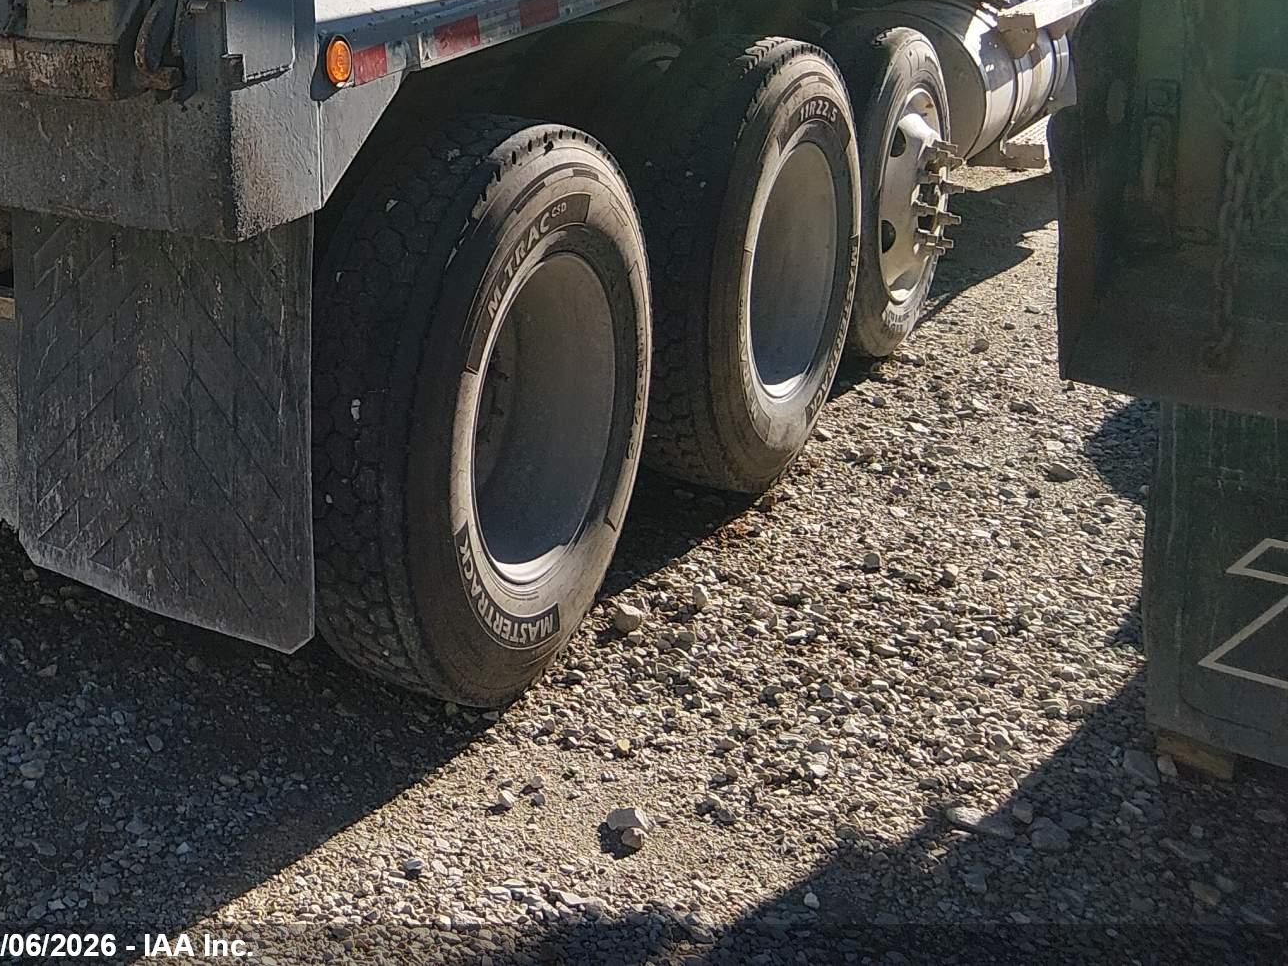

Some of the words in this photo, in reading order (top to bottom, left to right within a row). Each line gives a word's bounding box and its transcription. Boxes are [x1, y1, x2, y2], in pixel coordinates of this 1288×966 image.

[800, 99, 838, 123] 11R22.5
[487, 212, 550, 320] M-TRAC
[459, 534, 554, 644] MASTERTRACK
